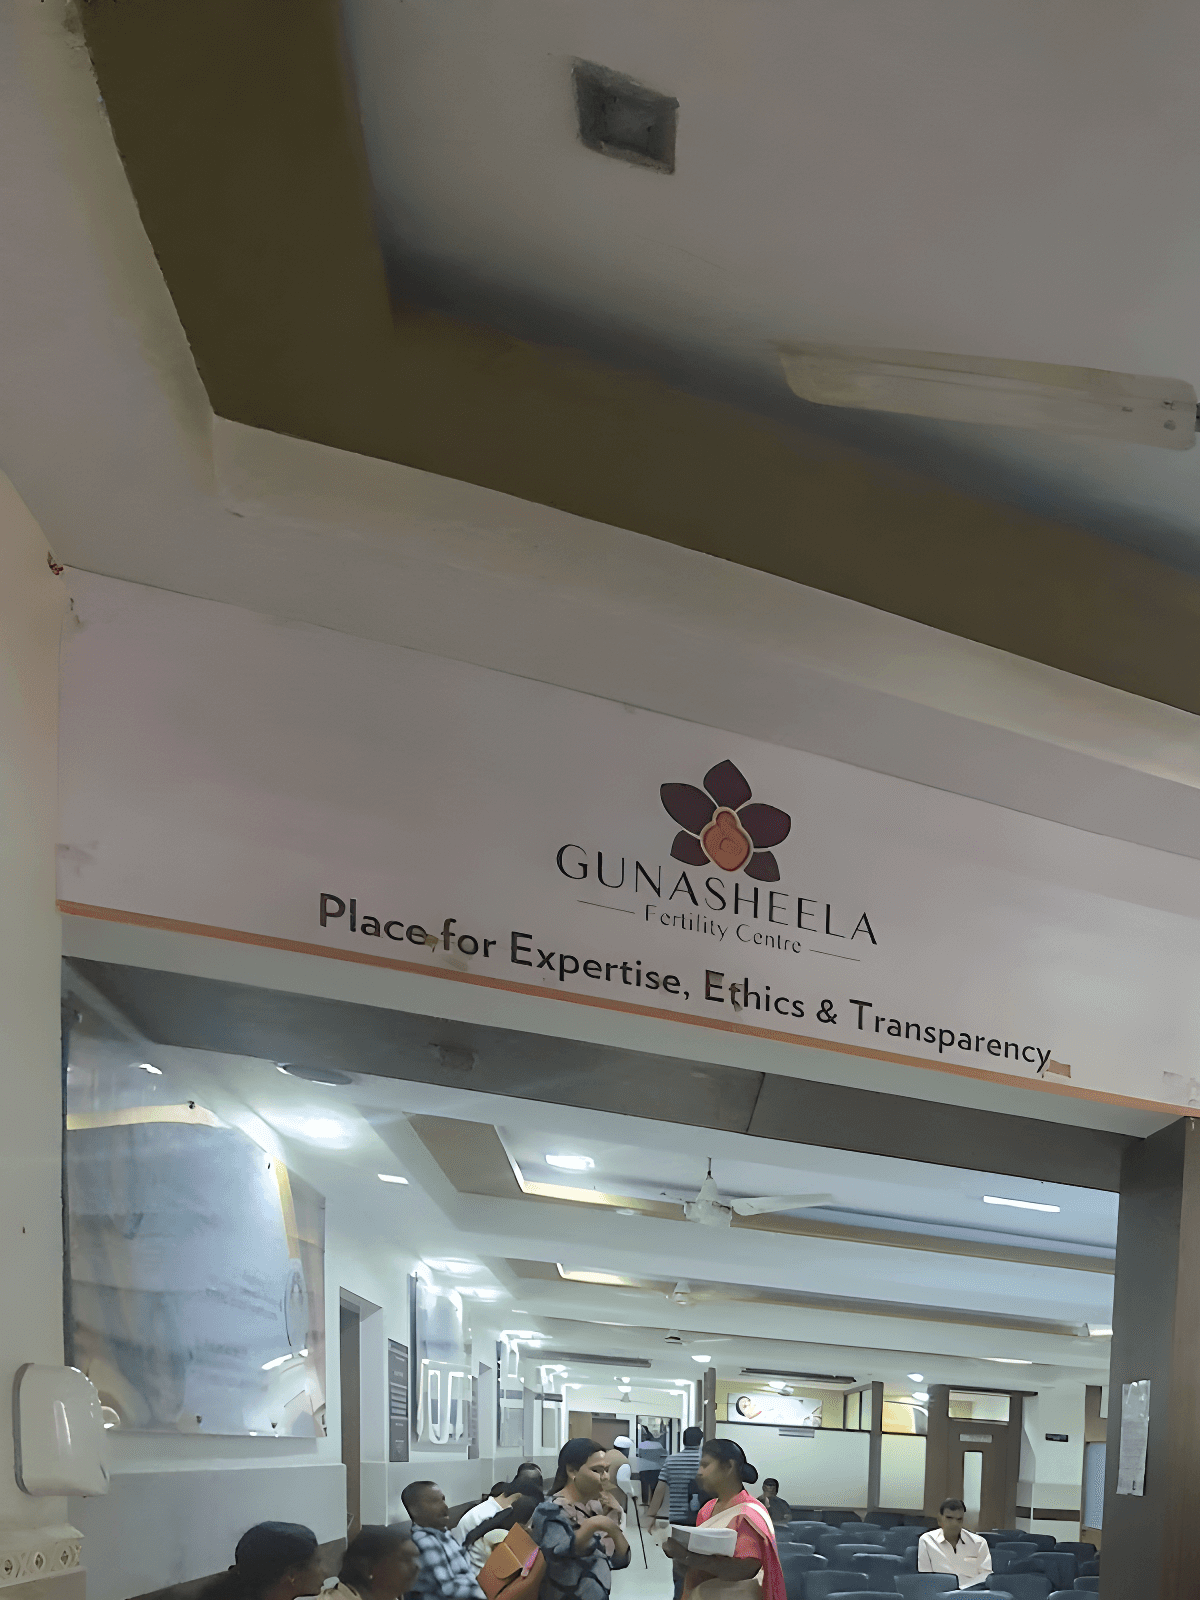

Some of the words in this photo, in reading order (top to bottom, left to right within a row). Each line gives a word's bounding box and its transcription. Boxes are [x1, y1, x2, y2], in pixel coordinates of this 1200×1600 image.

[556, 844, 877, 945] GUNASHEELA
[645, 904, 728, 942] Fertility
[736, 923, 801, 954] Centre
[319, 892, 429, 947] Place
[440, 918, 497, 957] for
[510, 931, 690, 1001] Expertise,
[704, 969, 805, 1019] Ethics
[816, 999, 838, 1025] &
[849, 999, 1051, 1076] Transparency
